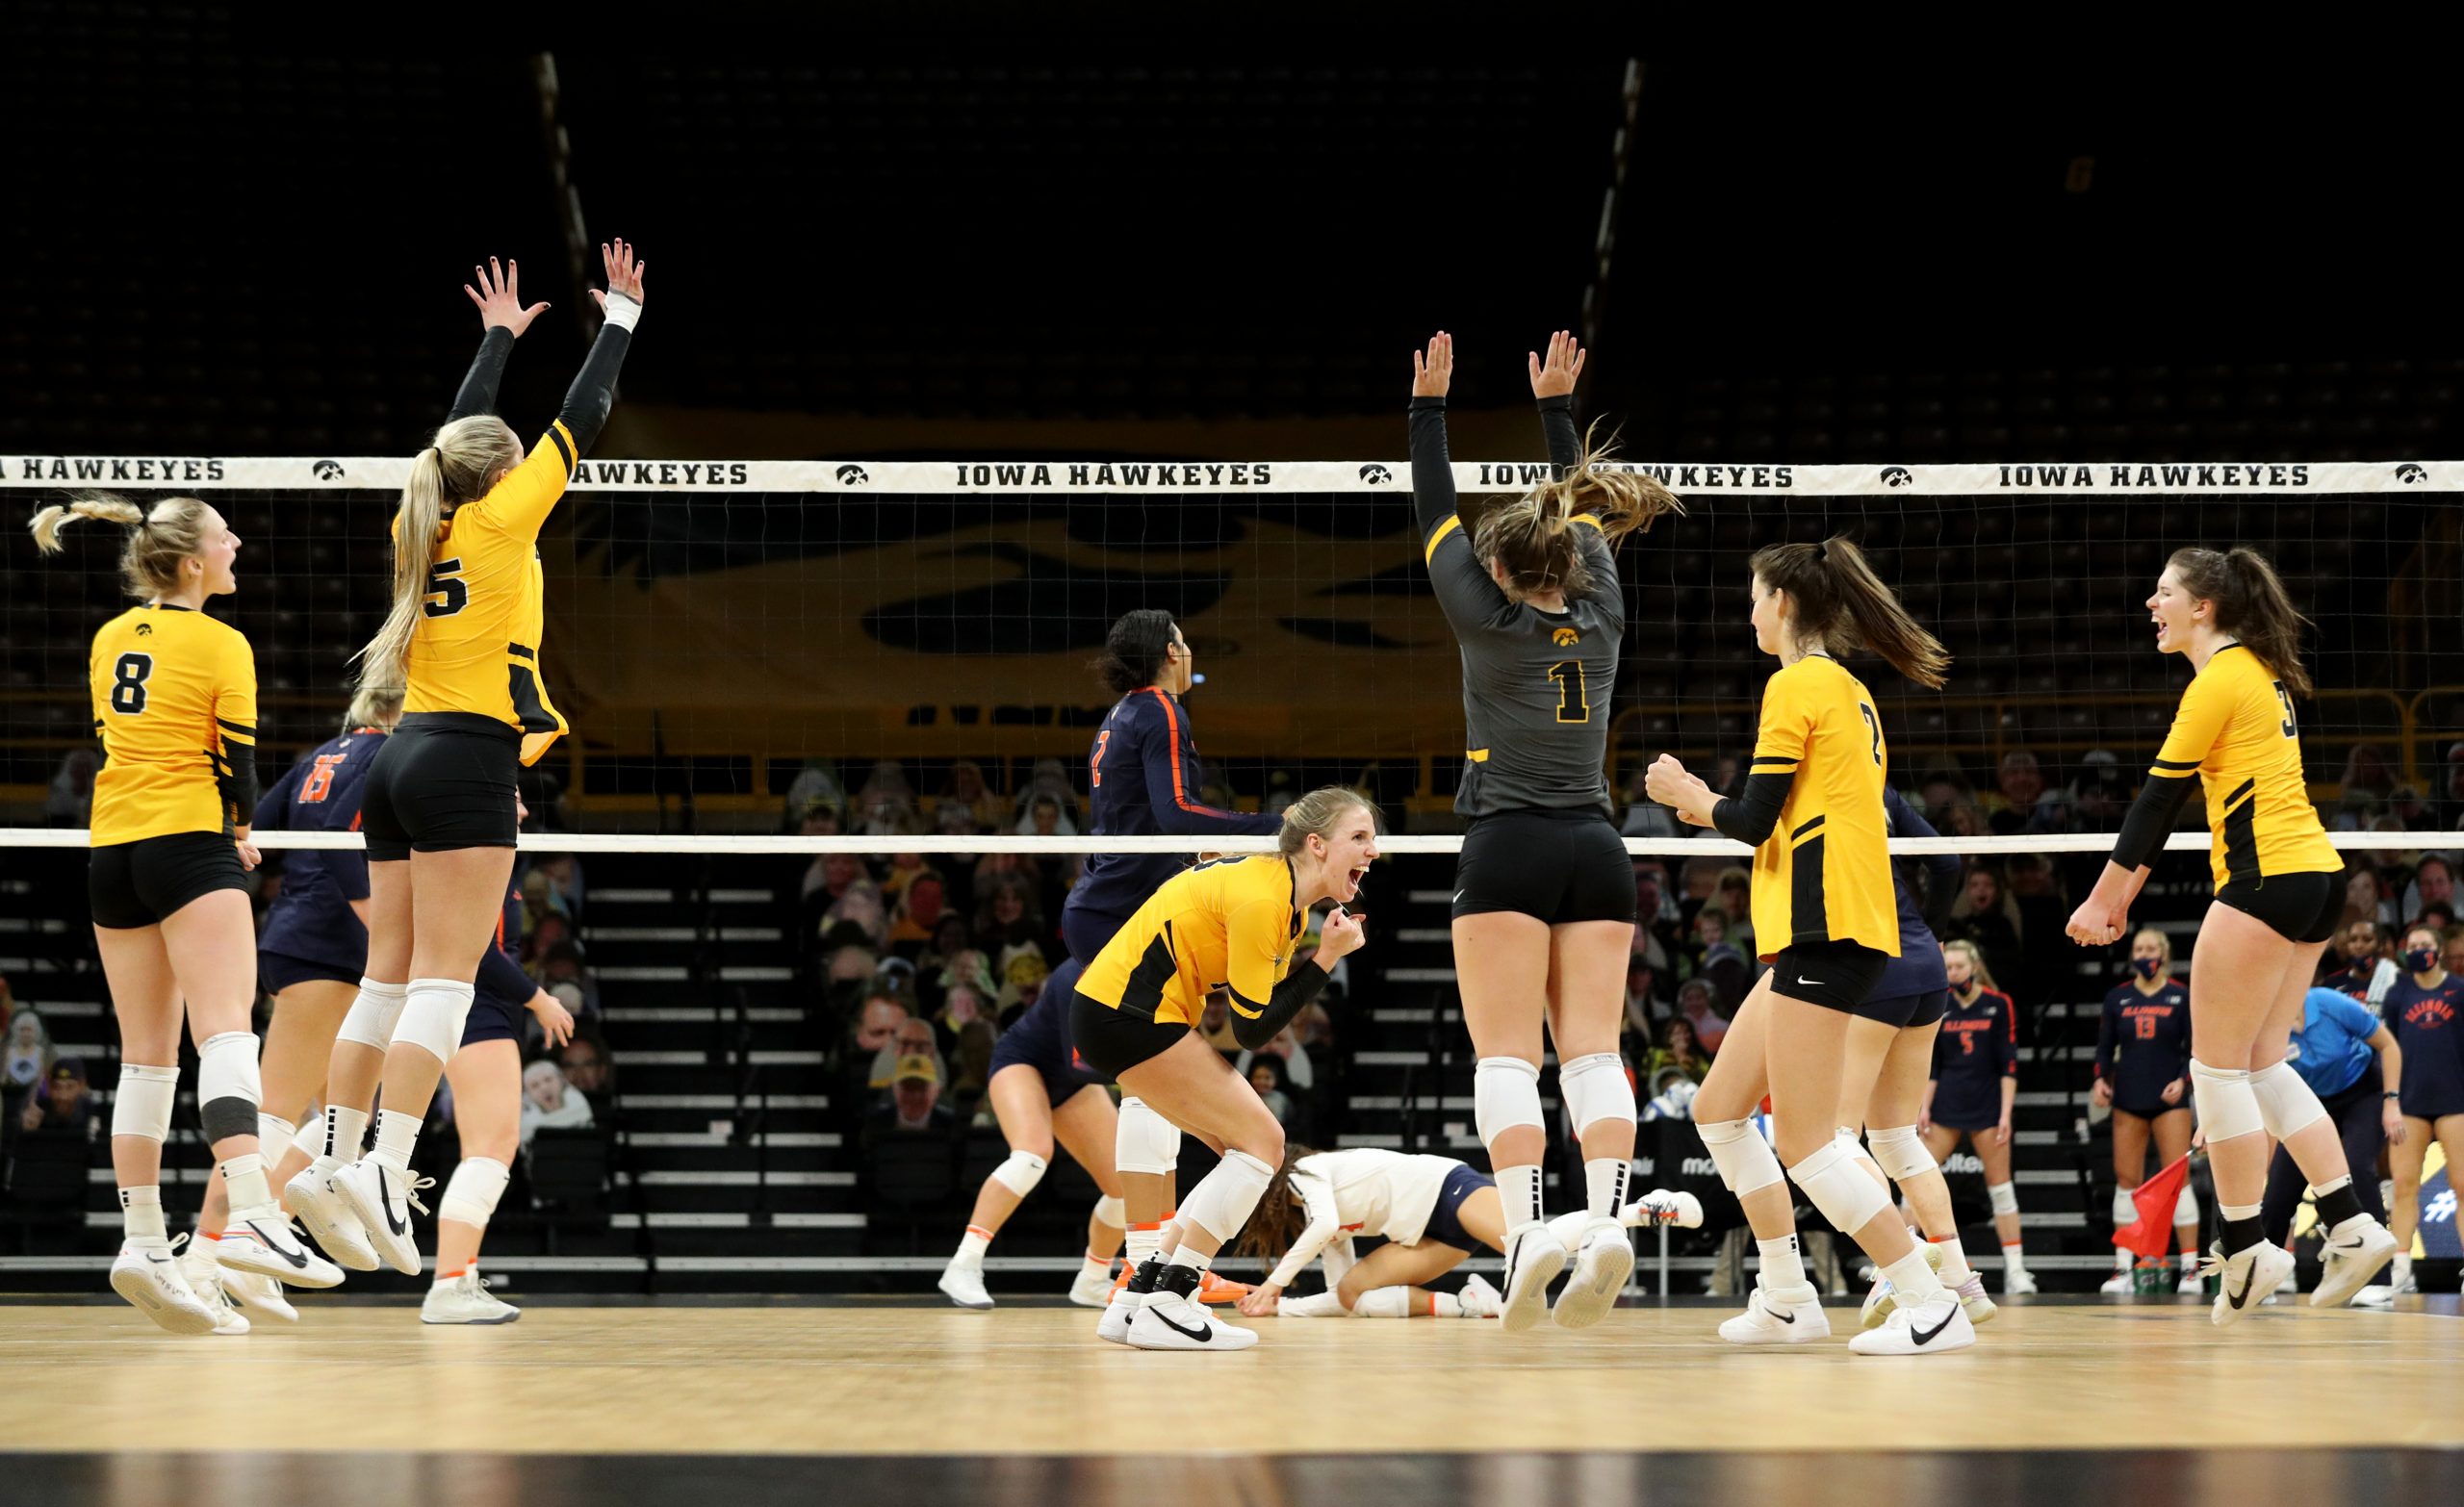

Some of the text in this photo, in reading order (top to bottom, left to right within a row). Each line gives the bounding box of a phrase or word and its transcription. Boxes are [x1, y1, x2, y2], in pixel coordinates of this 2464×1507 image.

[23, 459, 224, 480] HAWKEYES
[571, 463, 747, 485] AWKEYES
[957, 464, 1270, 486] IOWA HAWKEYES
[1479, 464, 1549, 485] IOW
[1999, 466, 2308, 487] IOWA HAWKEYES
[422, 556, 470, 620] 5
[111, 651, 155, 716] 8
[1548, 658, 1590, 724] 1
[2134, 1015, 2157, 1039] 13
